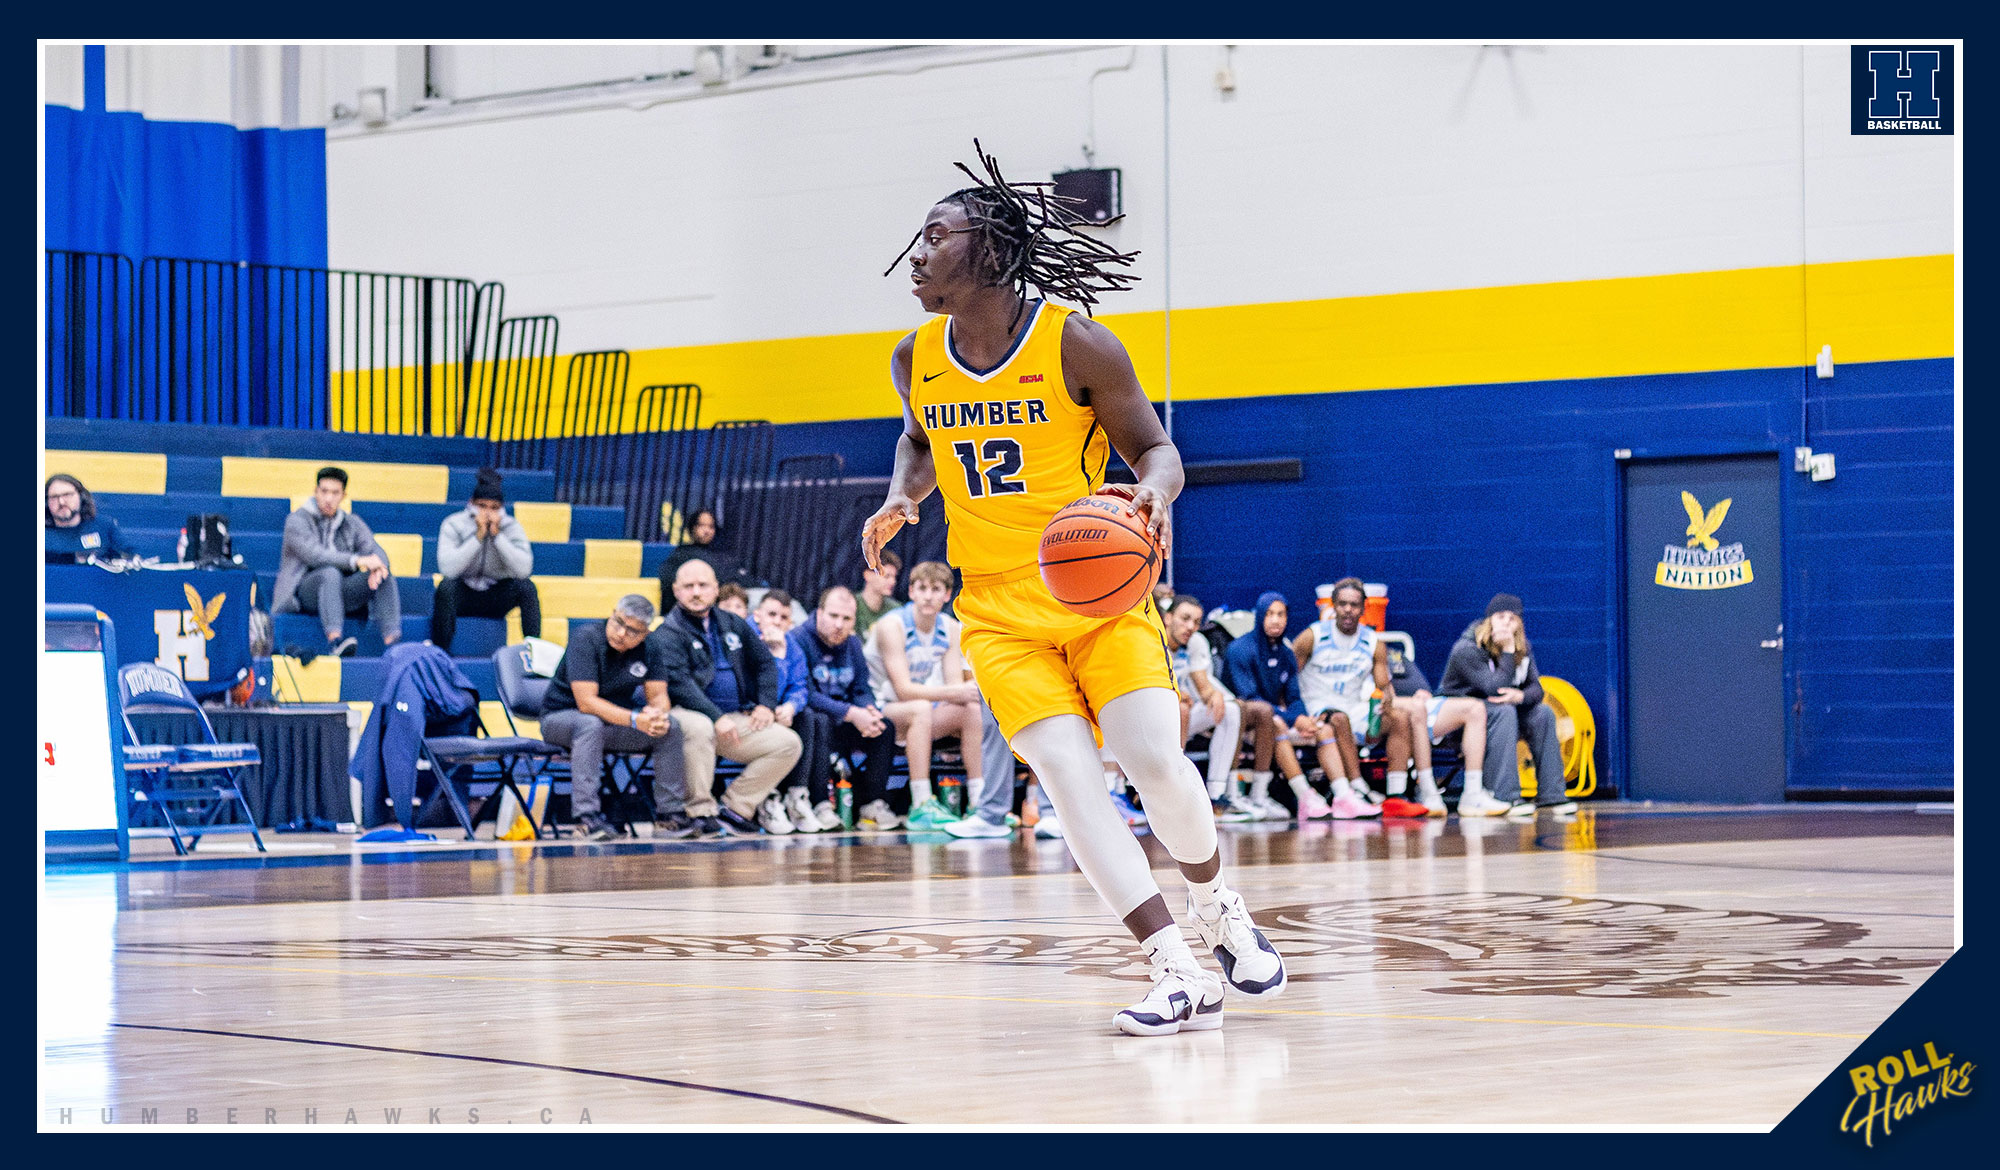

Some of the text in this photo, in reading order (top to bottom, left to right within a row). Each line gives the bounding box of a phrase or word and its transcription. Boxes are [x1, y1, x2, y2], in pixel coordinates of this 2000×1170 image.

[922, 398, 1050, 430] HUMBER
[952, 437, 1028, 499] 12
[1041, 528, 1109, 548] EVOLUTION
[1665, 567, 1743, 586] NATION
[154, 609, 210, 681] H
